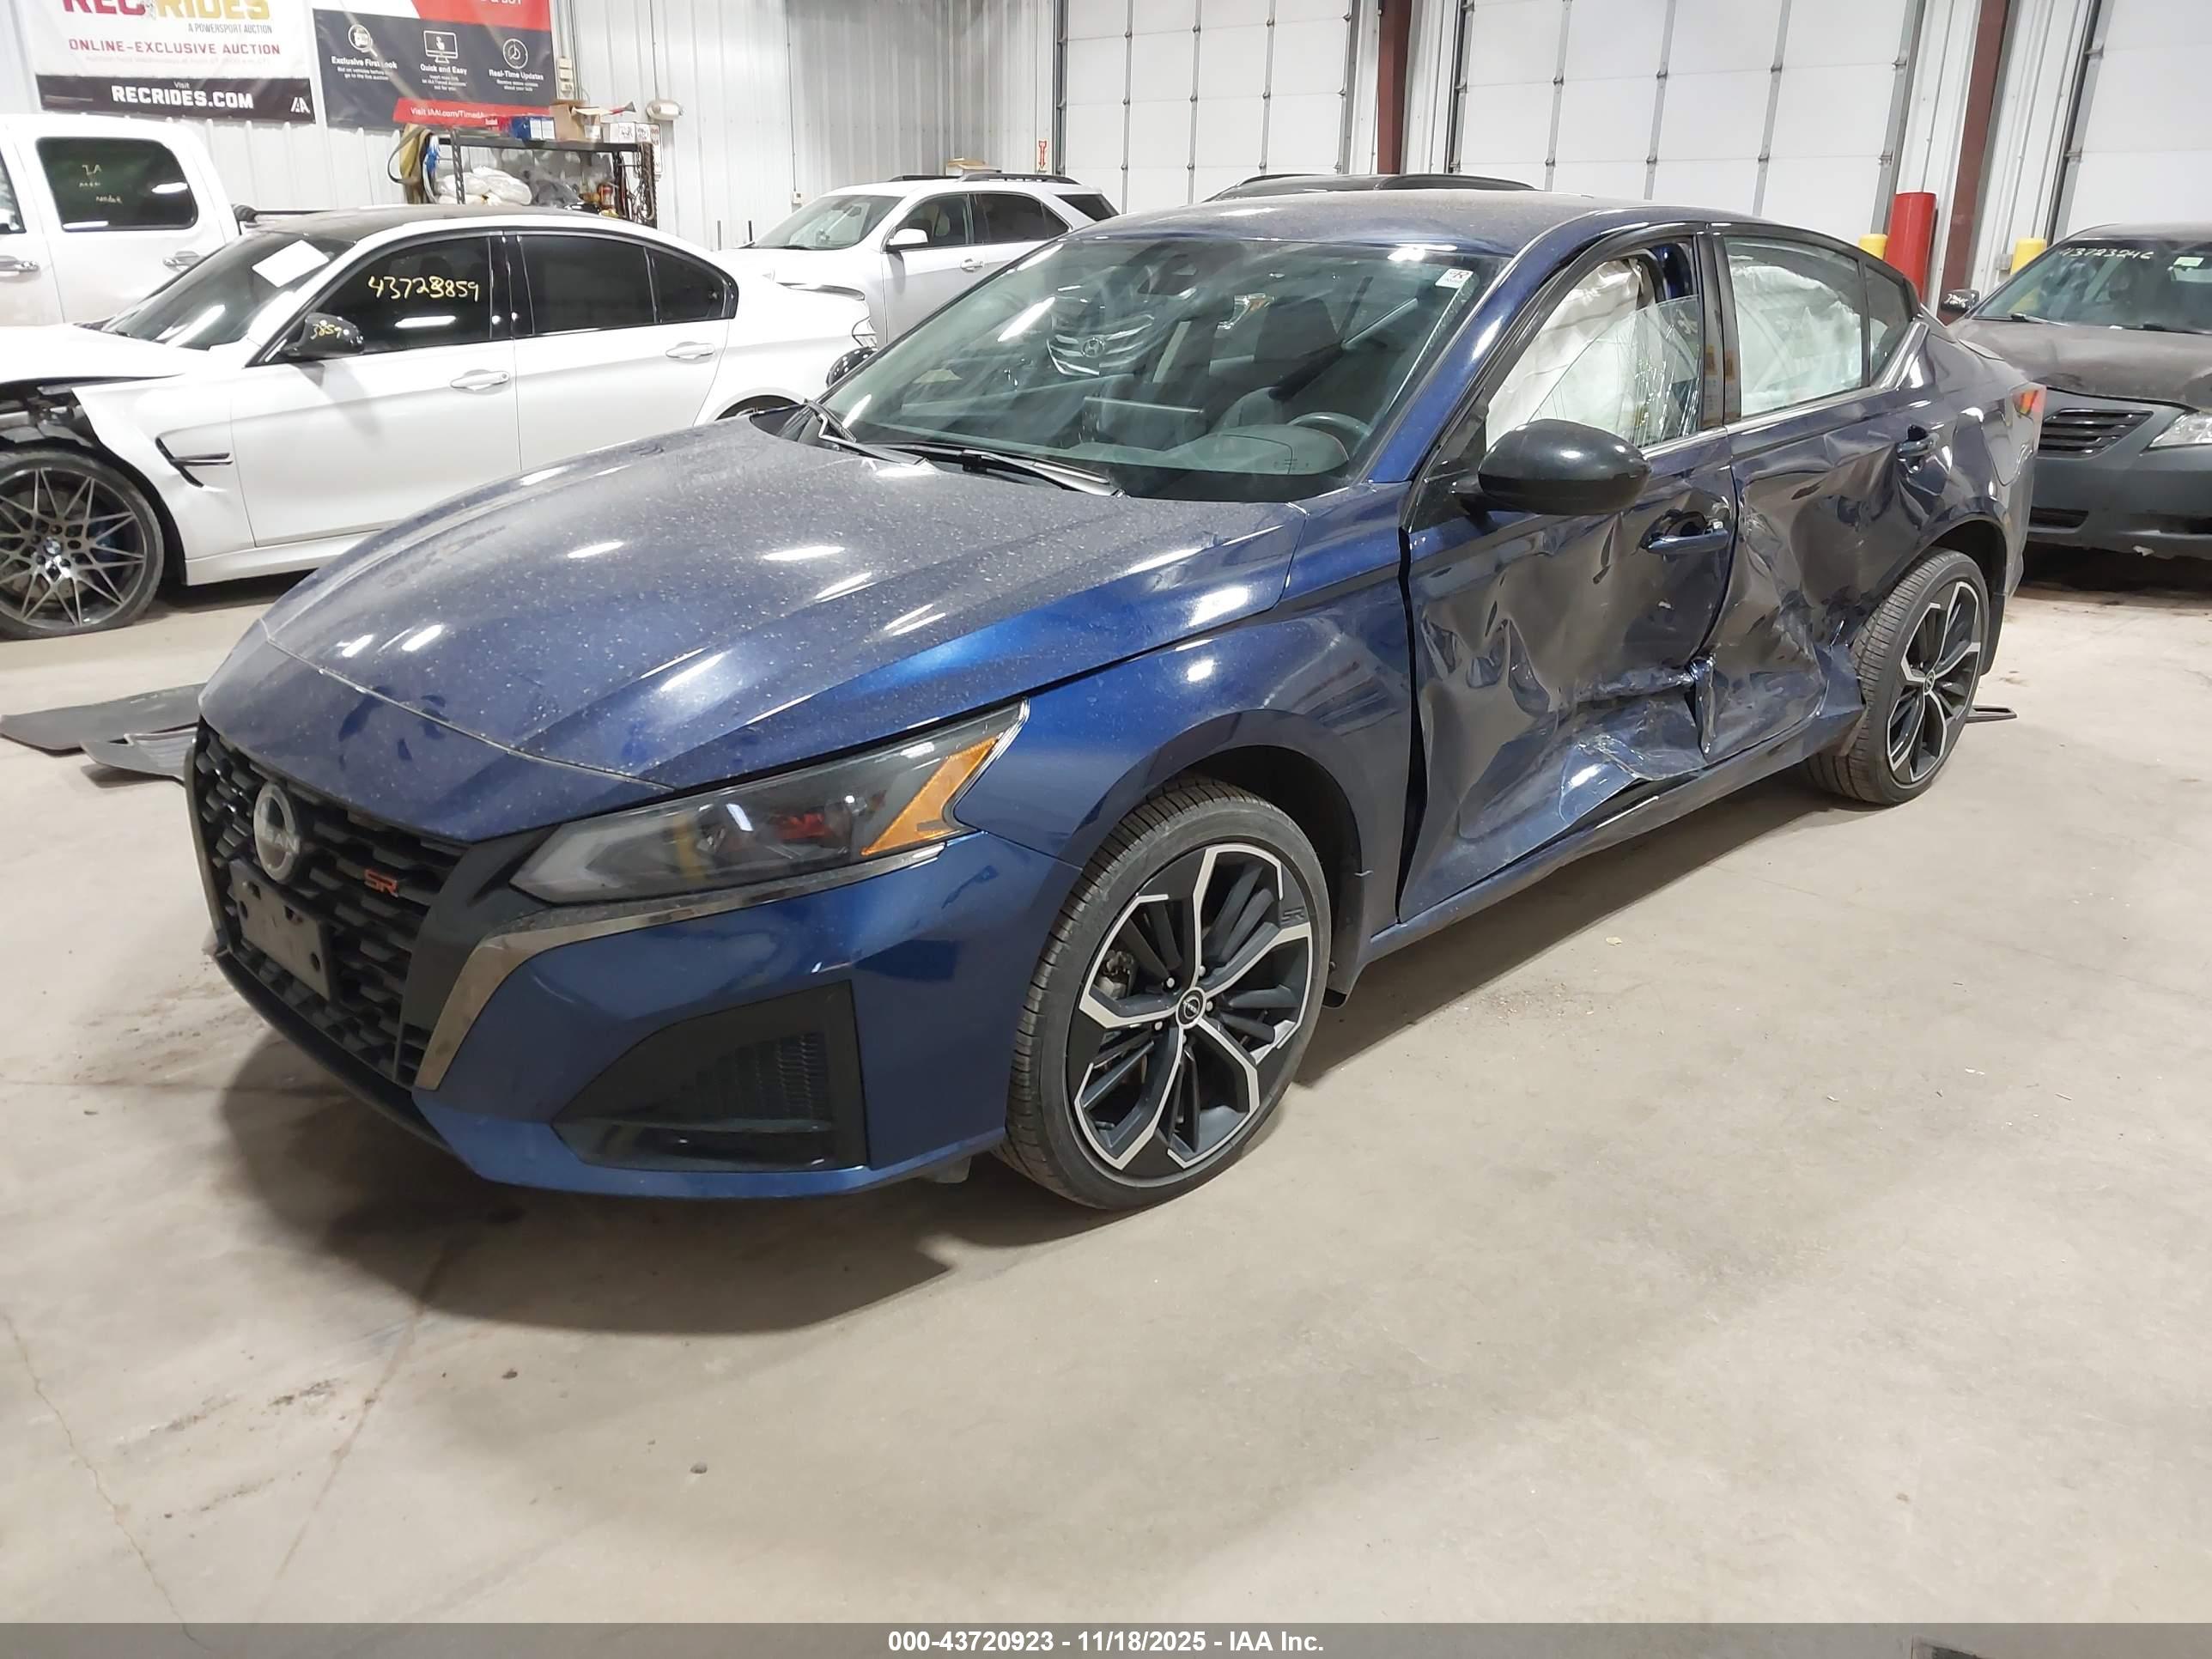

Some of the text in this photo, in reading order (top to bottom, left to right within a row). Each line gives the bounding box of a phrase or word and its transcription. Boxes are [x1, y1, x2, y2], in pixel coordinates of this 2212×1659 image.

[188, 22, 272, 33] A POWERSPORT AUCTION
[68, 38, 281, 54] ONLINE-EXCLUSIVE AUCTION
[331, 56, 364, 66] Exclusive
[420, 64, 438, 72] Quick
[452, 65, 467, 76] Easy
[489, 69, 544, 81] Real-Time Updates
[111, 85, 254, 109] RECRIDES.COM
[410, 106, 427, 116] Visit
[364, 867, 399, 898] SR
